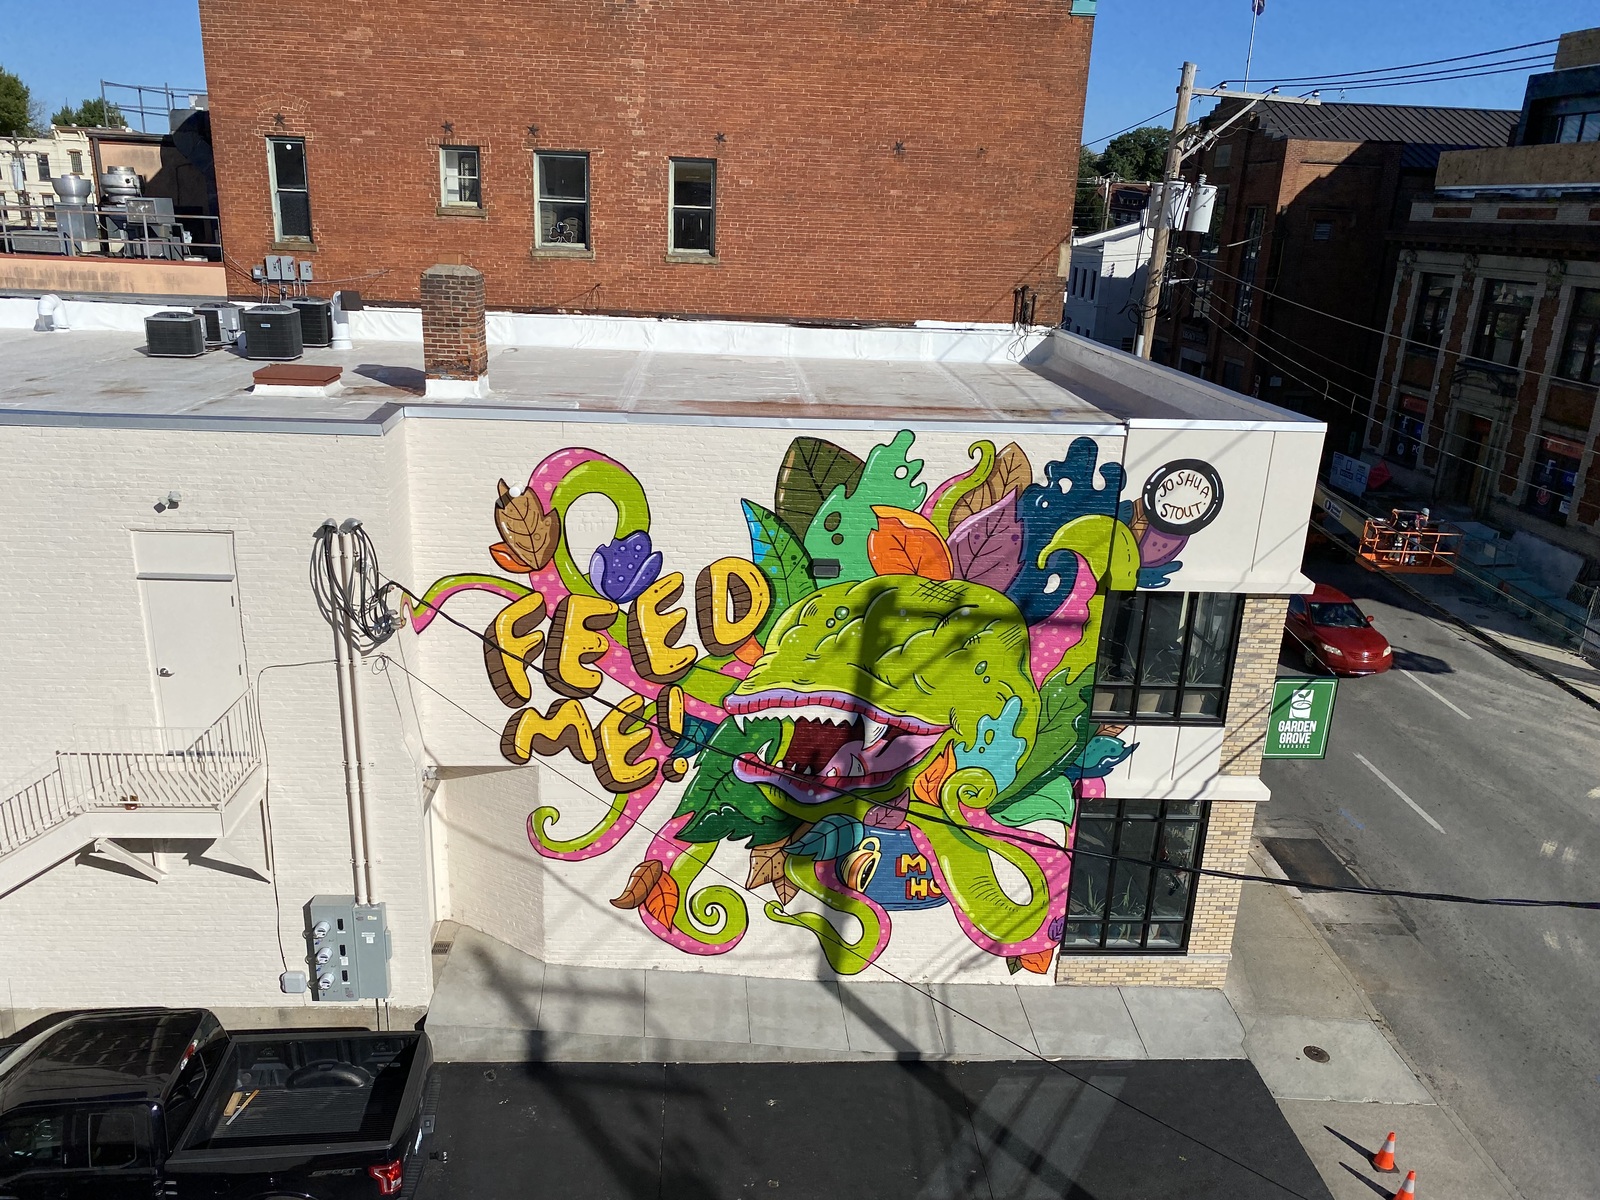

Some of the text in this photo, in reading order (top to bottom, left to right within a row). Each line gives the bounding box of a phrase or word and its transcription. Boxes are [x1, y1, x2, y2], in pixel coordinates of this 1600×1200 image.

[1158, 471, 1210, 498] JOSHUA
[1160, 501, 1202, 520] STOUT
[483, 556, 772, 709] FEED
[1278, 720, 1318, 733] GARDEN
[1279, 732, 1312, 744] GROVE
[500, 684, 689, 794] ME!
